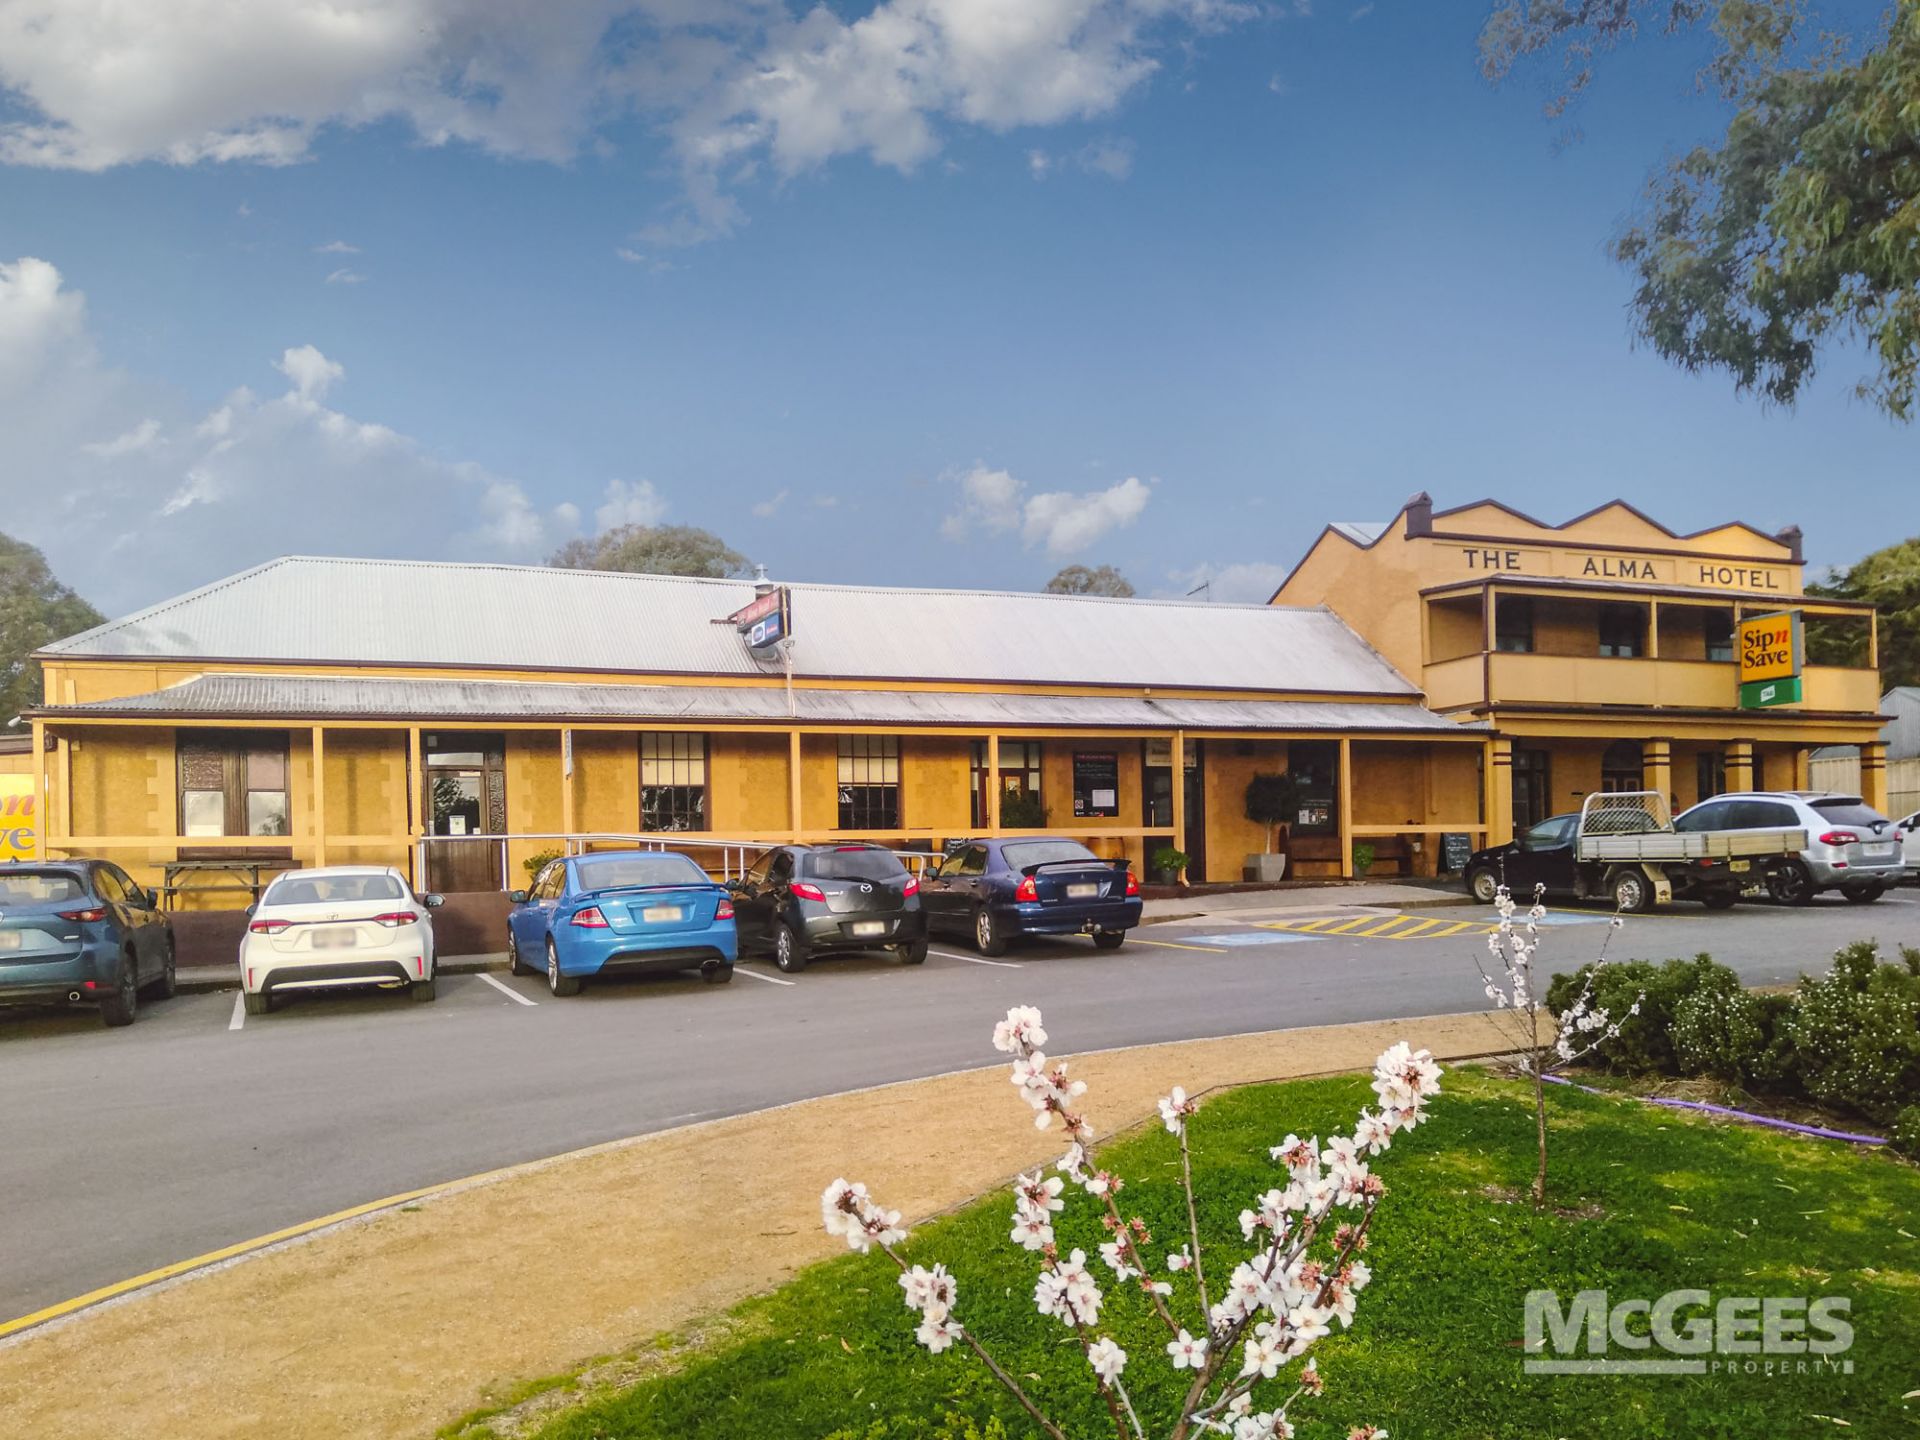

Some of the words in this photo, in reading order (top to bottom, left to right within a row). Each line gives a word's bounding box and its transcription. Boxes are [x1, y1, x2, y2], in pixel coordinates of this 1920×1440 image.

[1463, 549, 1521, 570] THE
[1582, 557, 1657, 580] ALMA
[1700, 565, 1778, 589] HOTEL
[1744, 649, 1788, 669] Save
